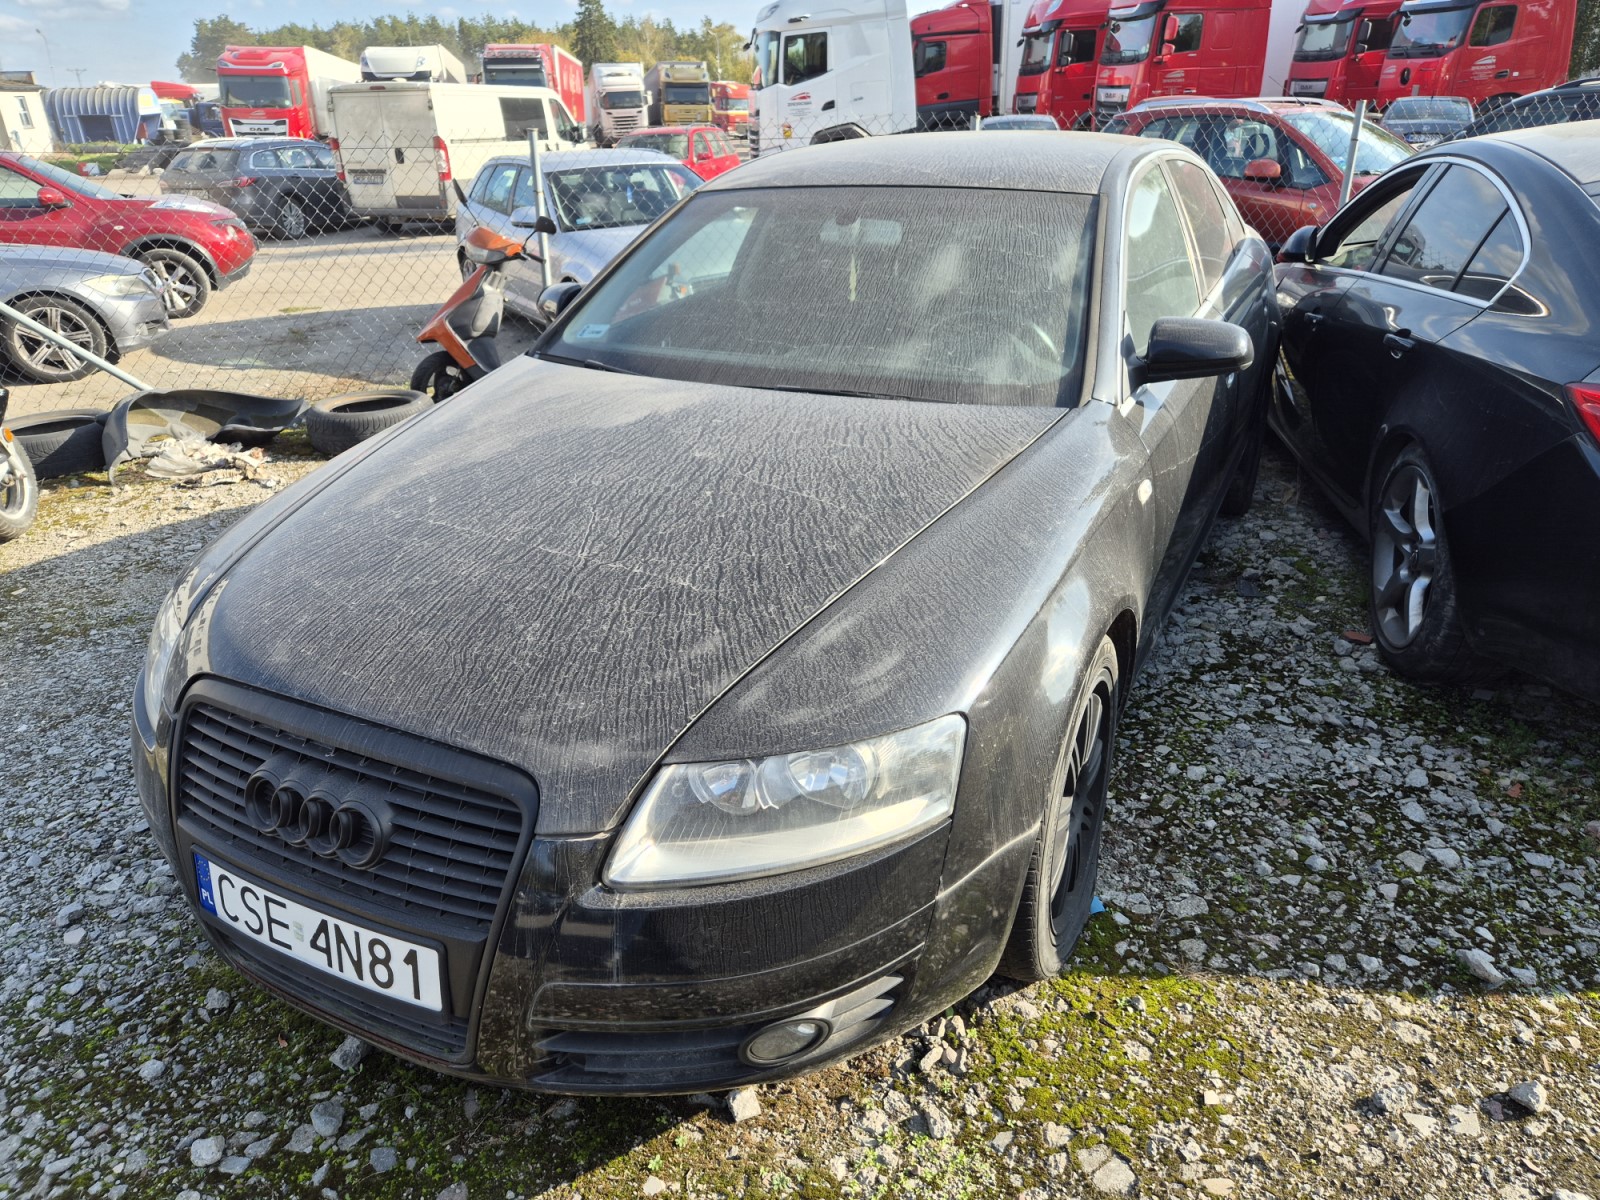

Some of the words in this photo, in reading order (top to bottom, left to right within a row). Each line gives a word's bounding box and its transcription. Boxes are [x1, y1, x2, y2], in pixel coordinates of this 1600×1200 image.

[201, 888, 214, 905] PL
[217, 873, 293, 951] CSE
[309, 918, 421, 1001] 4N81
